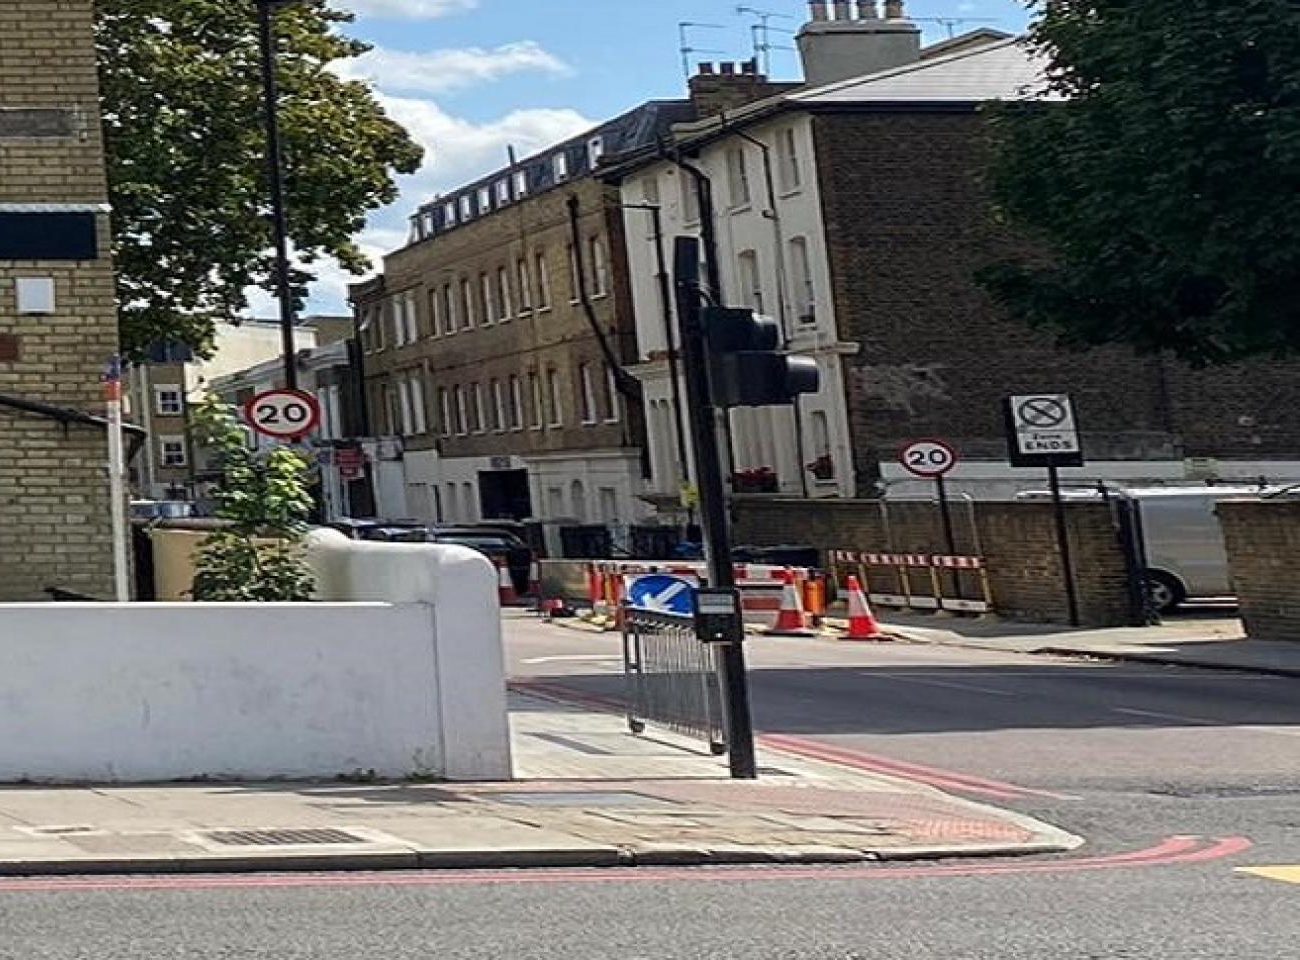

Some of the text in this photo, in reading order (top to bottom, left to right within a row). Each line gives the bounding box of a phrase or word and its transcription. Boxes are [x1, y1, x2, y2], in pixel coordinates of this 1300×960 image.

[258, 404, 307, 424] 20
[1024, 441, 1072, 451] ENDS
[908, 449, 946, 465] 20
